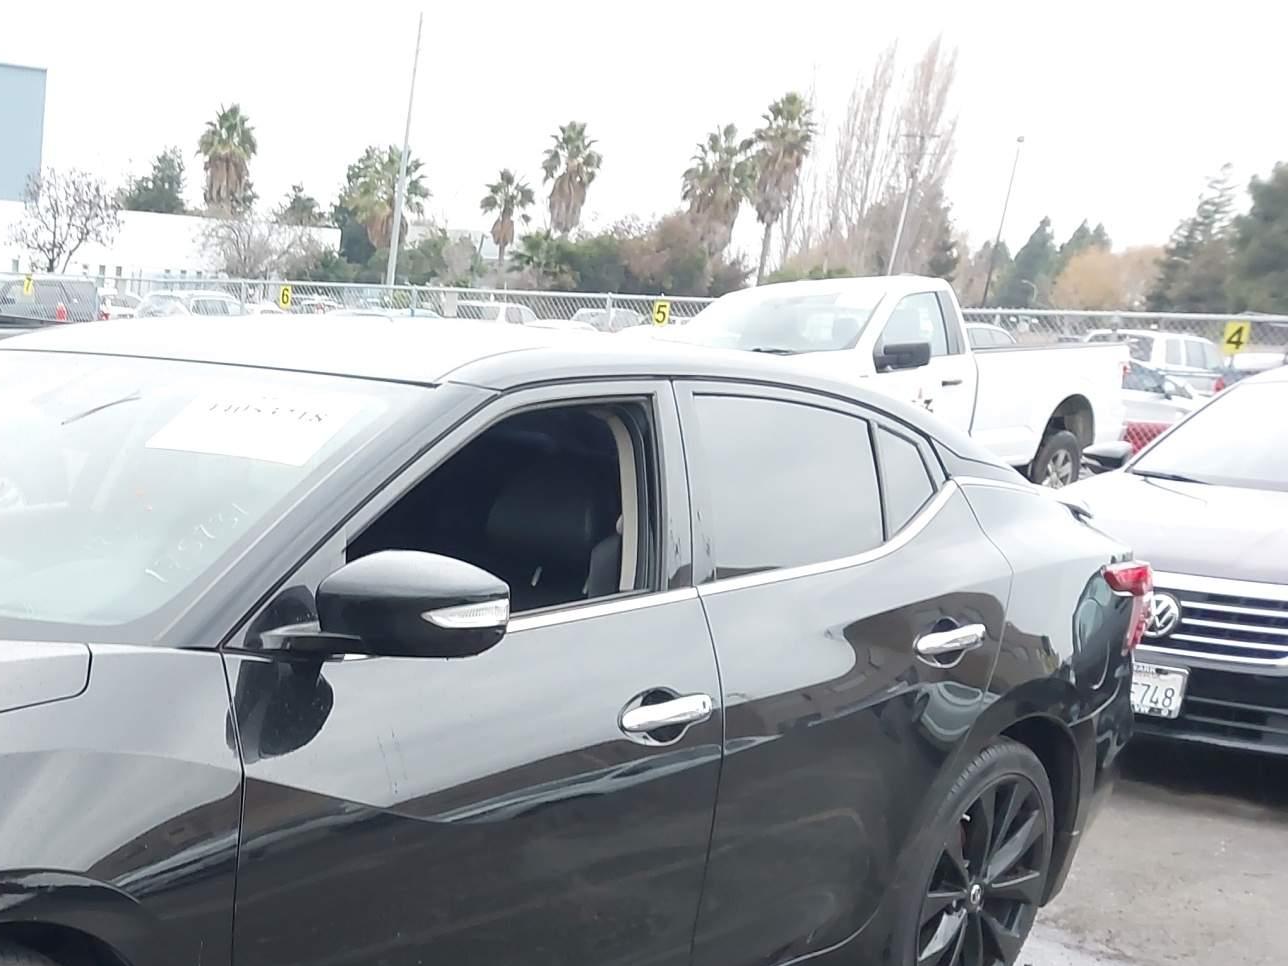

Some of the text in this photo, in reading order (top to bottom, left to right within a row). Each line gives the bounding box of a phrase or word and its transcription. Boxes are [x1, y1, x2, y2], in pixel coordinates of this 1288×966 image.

[282, 287, 289, 304] 6
[655, 305, 667, 323] 5
[1226, 326, 1244, 350] 4
